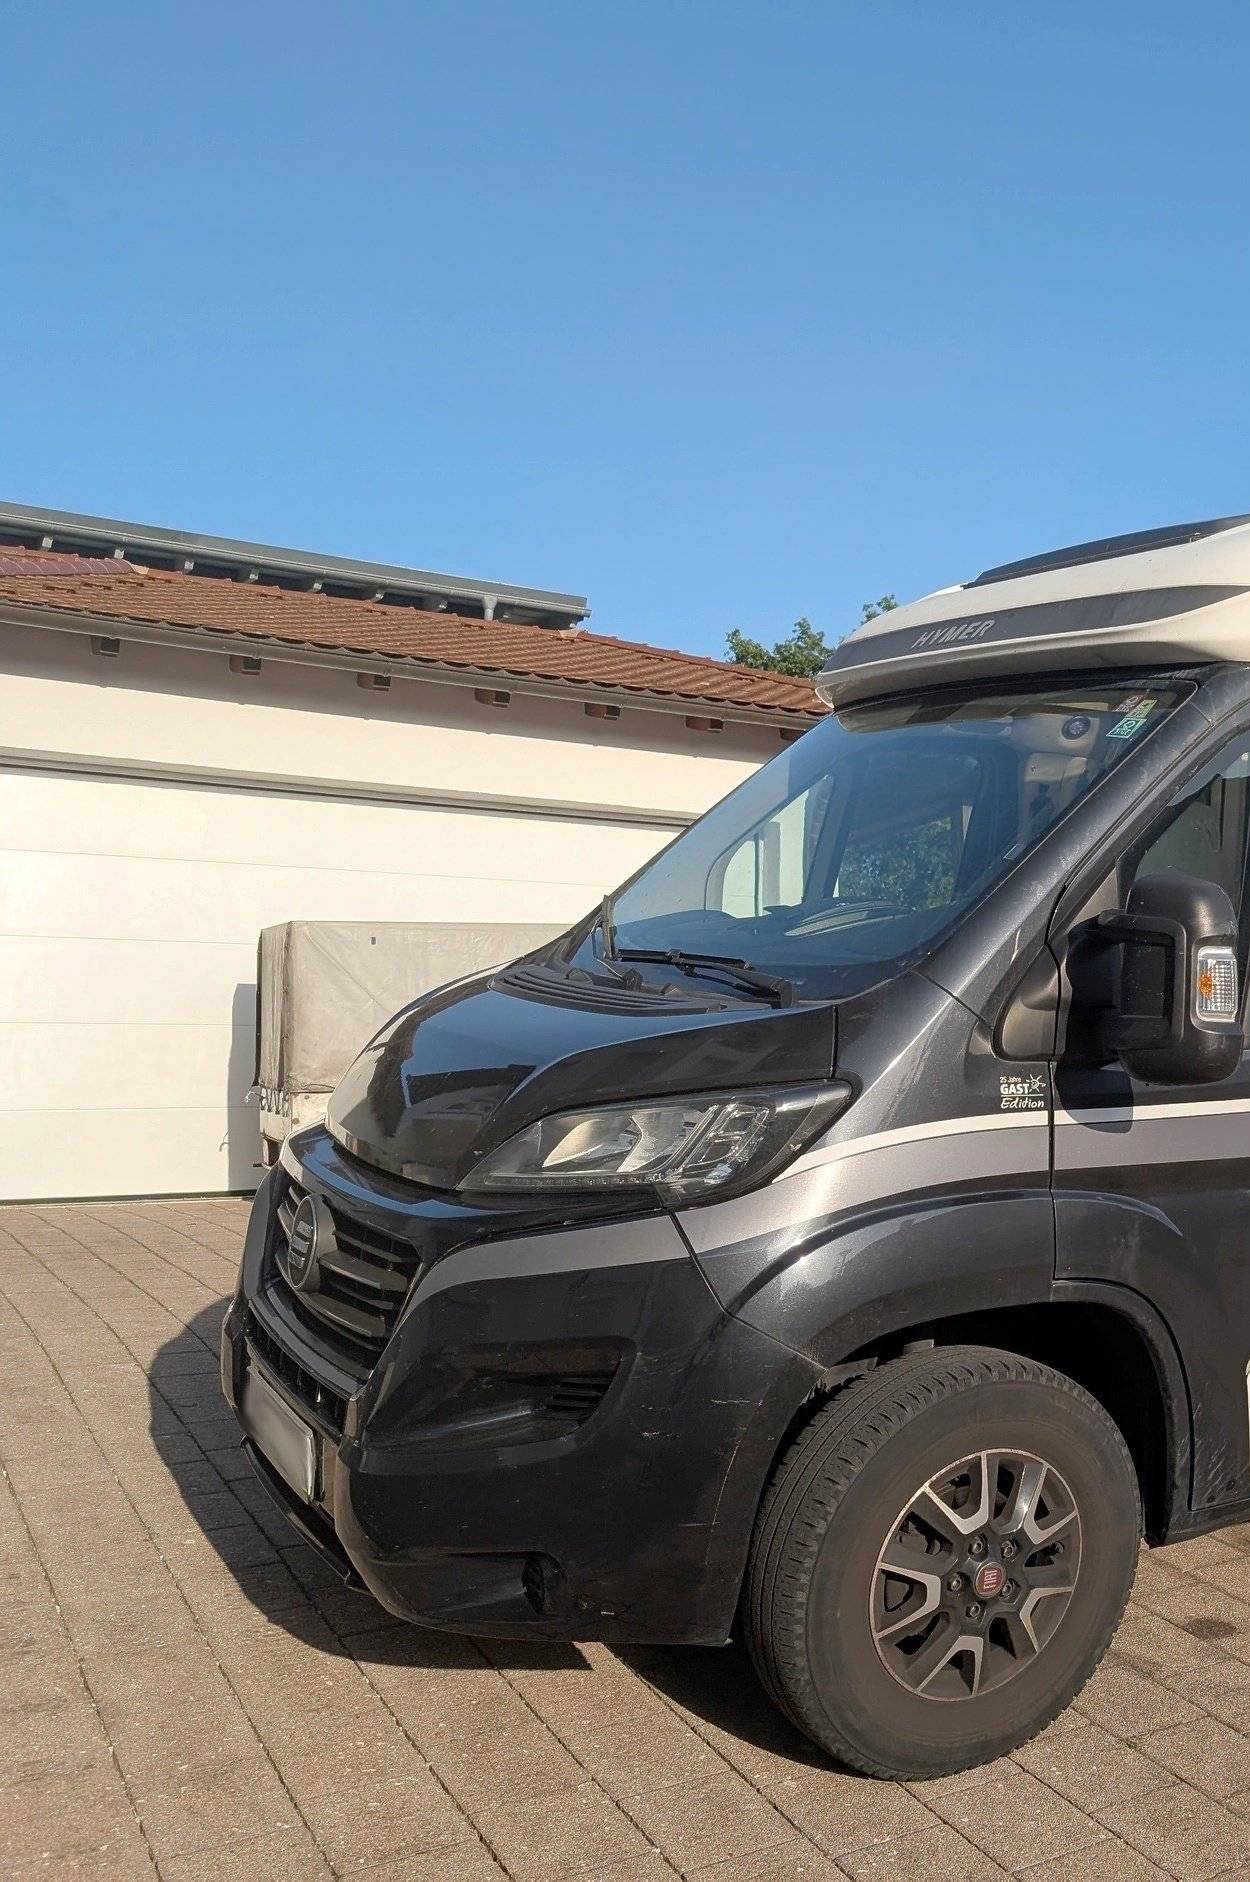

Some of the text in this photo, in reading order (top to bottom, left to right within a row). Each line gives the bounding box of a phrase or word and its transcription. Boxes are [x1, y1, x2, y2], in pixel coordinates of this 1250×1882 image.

[911, 619, 995, 649] HYMER
[1000, 1084, 1030, 1094] GAST
[1001, 1097, 1044, 1109] Edition
[983, 1569, 998, 1590] FIAT
